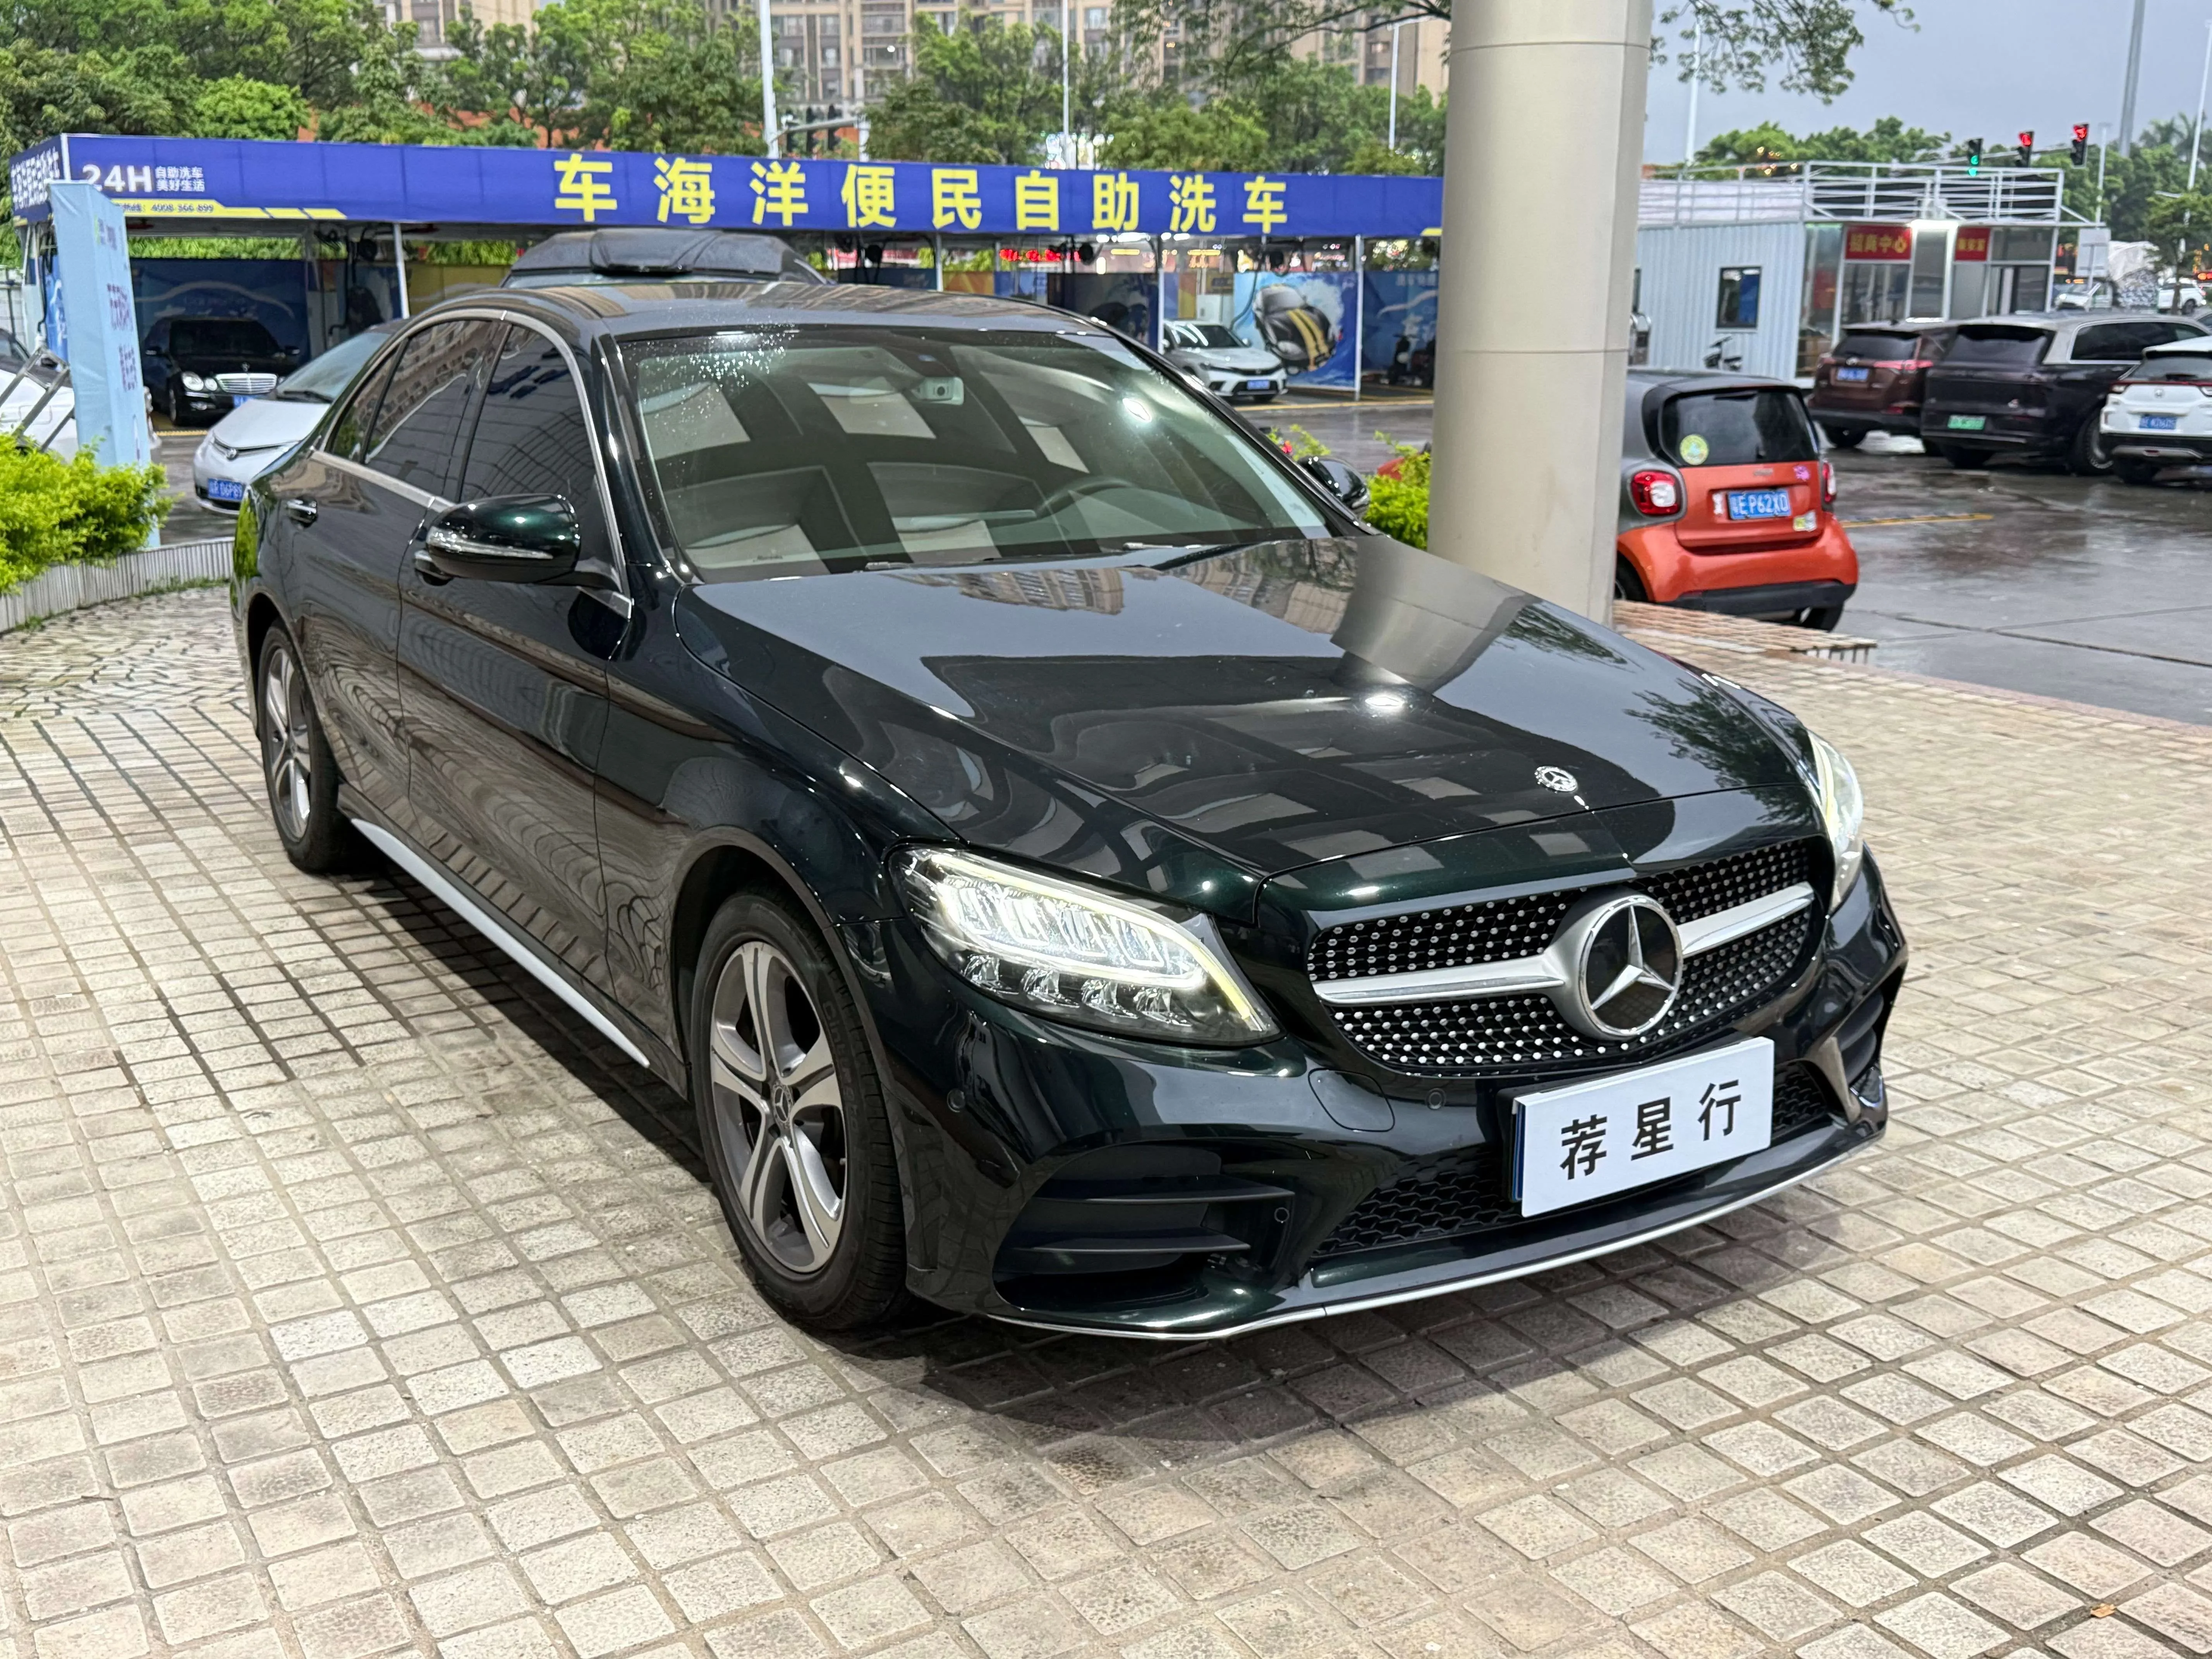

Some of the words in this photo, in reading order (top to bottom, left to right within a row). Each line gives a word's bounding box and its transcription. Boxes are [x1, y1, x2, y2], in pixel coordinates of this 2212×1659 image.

[82, 164, 153, 192] 24H
[155, 166, 204, 179] 自助洗车
[156, 178, 205, 192] 美好生活
[554, 153, 1288, 234] 车海洋便民自助洗车
[1560, 1079, 1741, 1180] 荐星行
